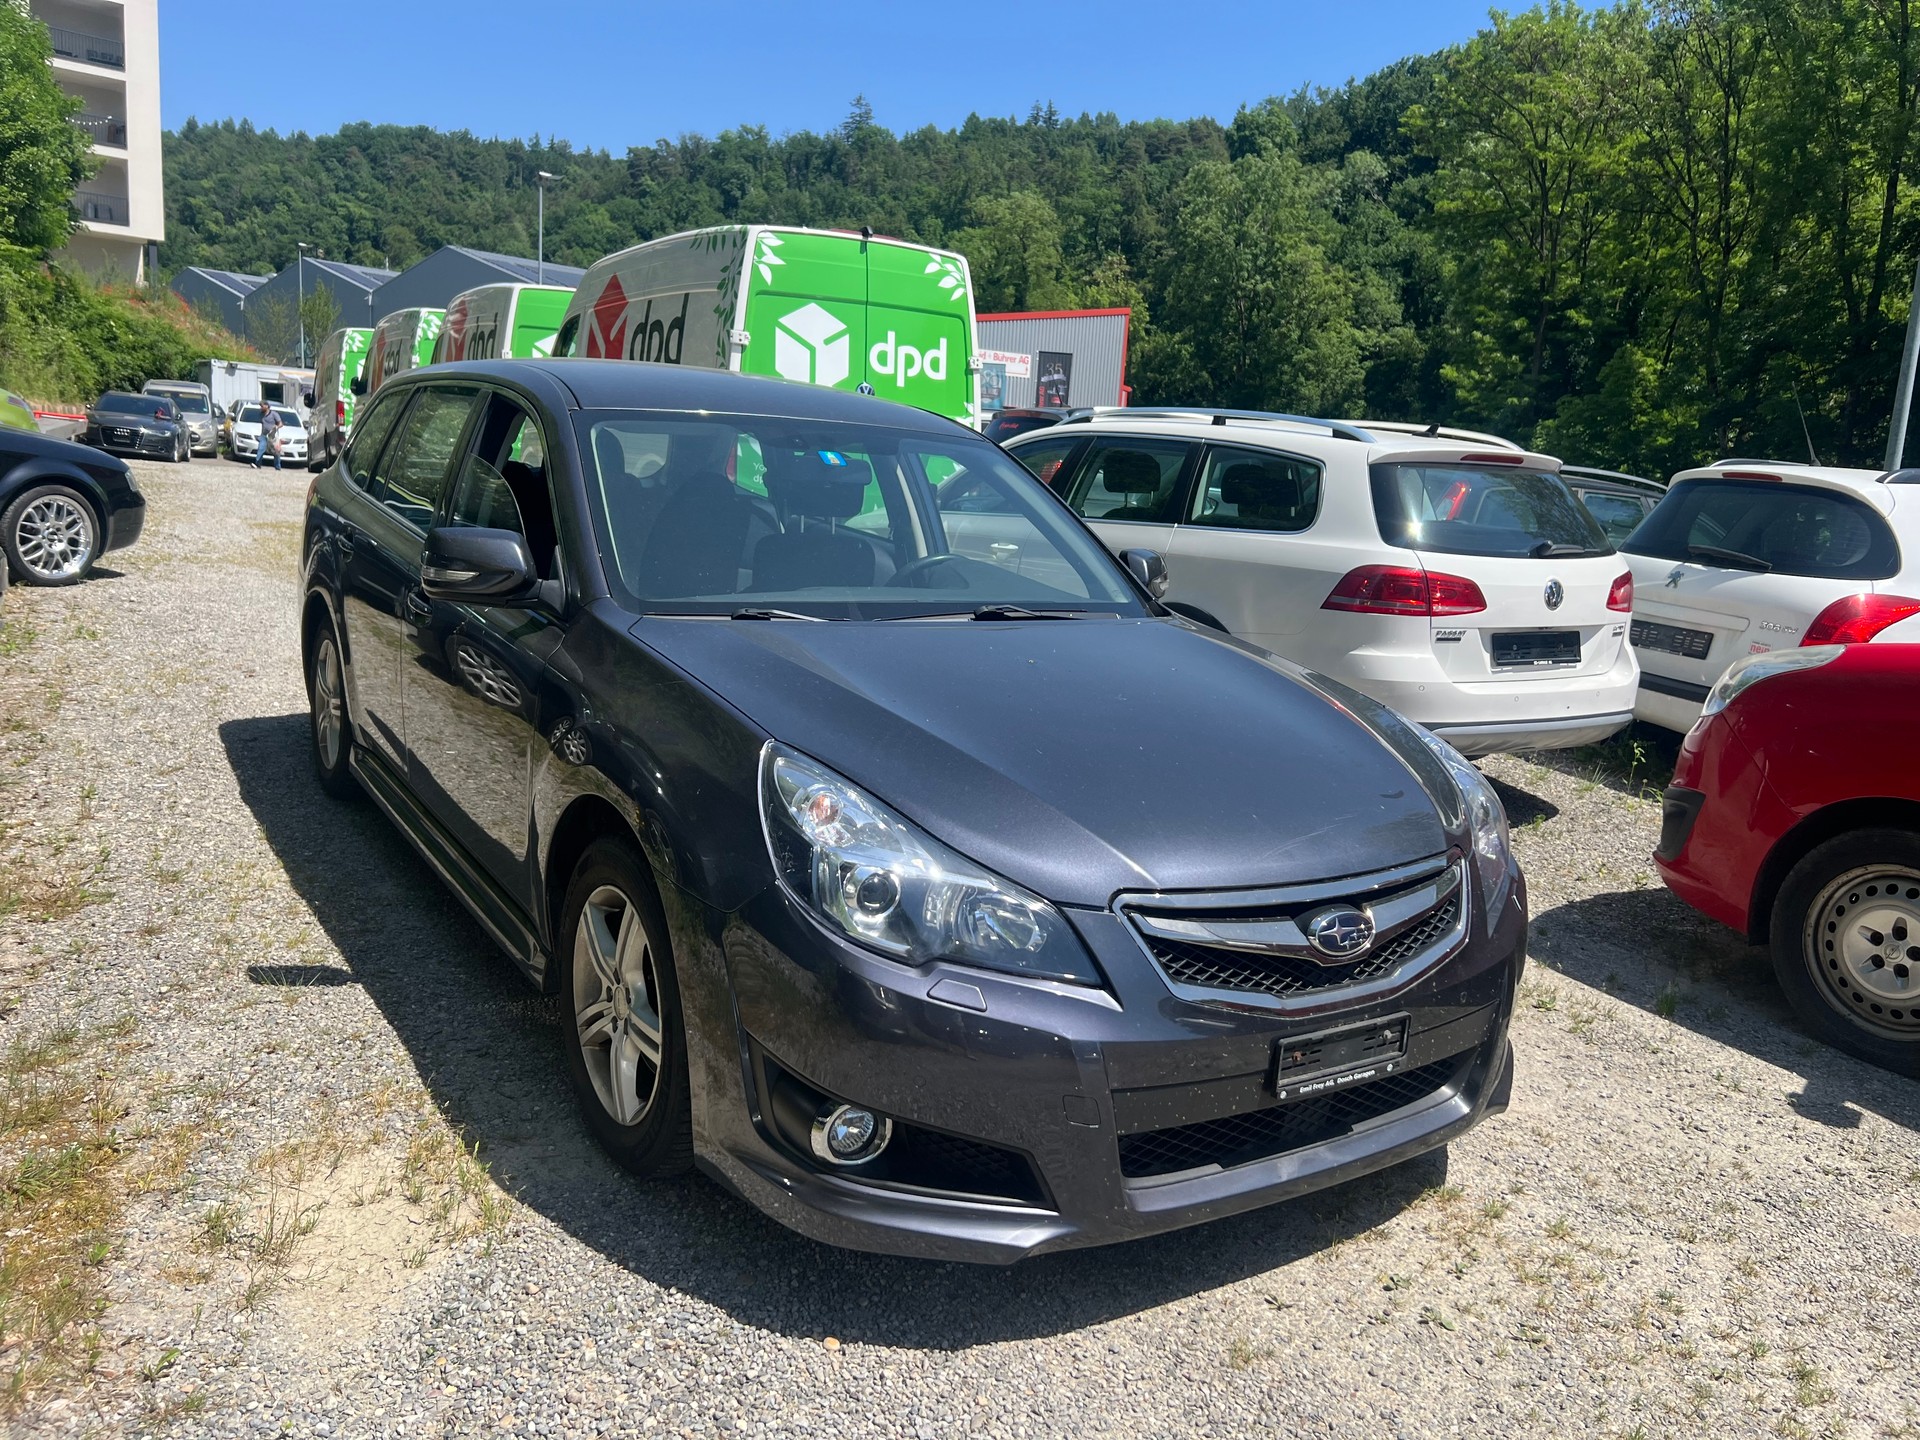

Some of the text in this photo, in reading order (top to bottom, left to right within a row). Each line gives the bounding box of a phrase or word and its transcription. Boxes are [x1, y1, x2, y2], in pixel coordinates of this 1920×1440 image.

[629, 292, 690, 364] dpd
[869, 330, 948, 388] dpd
[1299, 1084, 1312, 1093] Emil
[1313, 1082, 1325, 1090] Frey
[1354, 1069, 1376, 1080] Garagen
